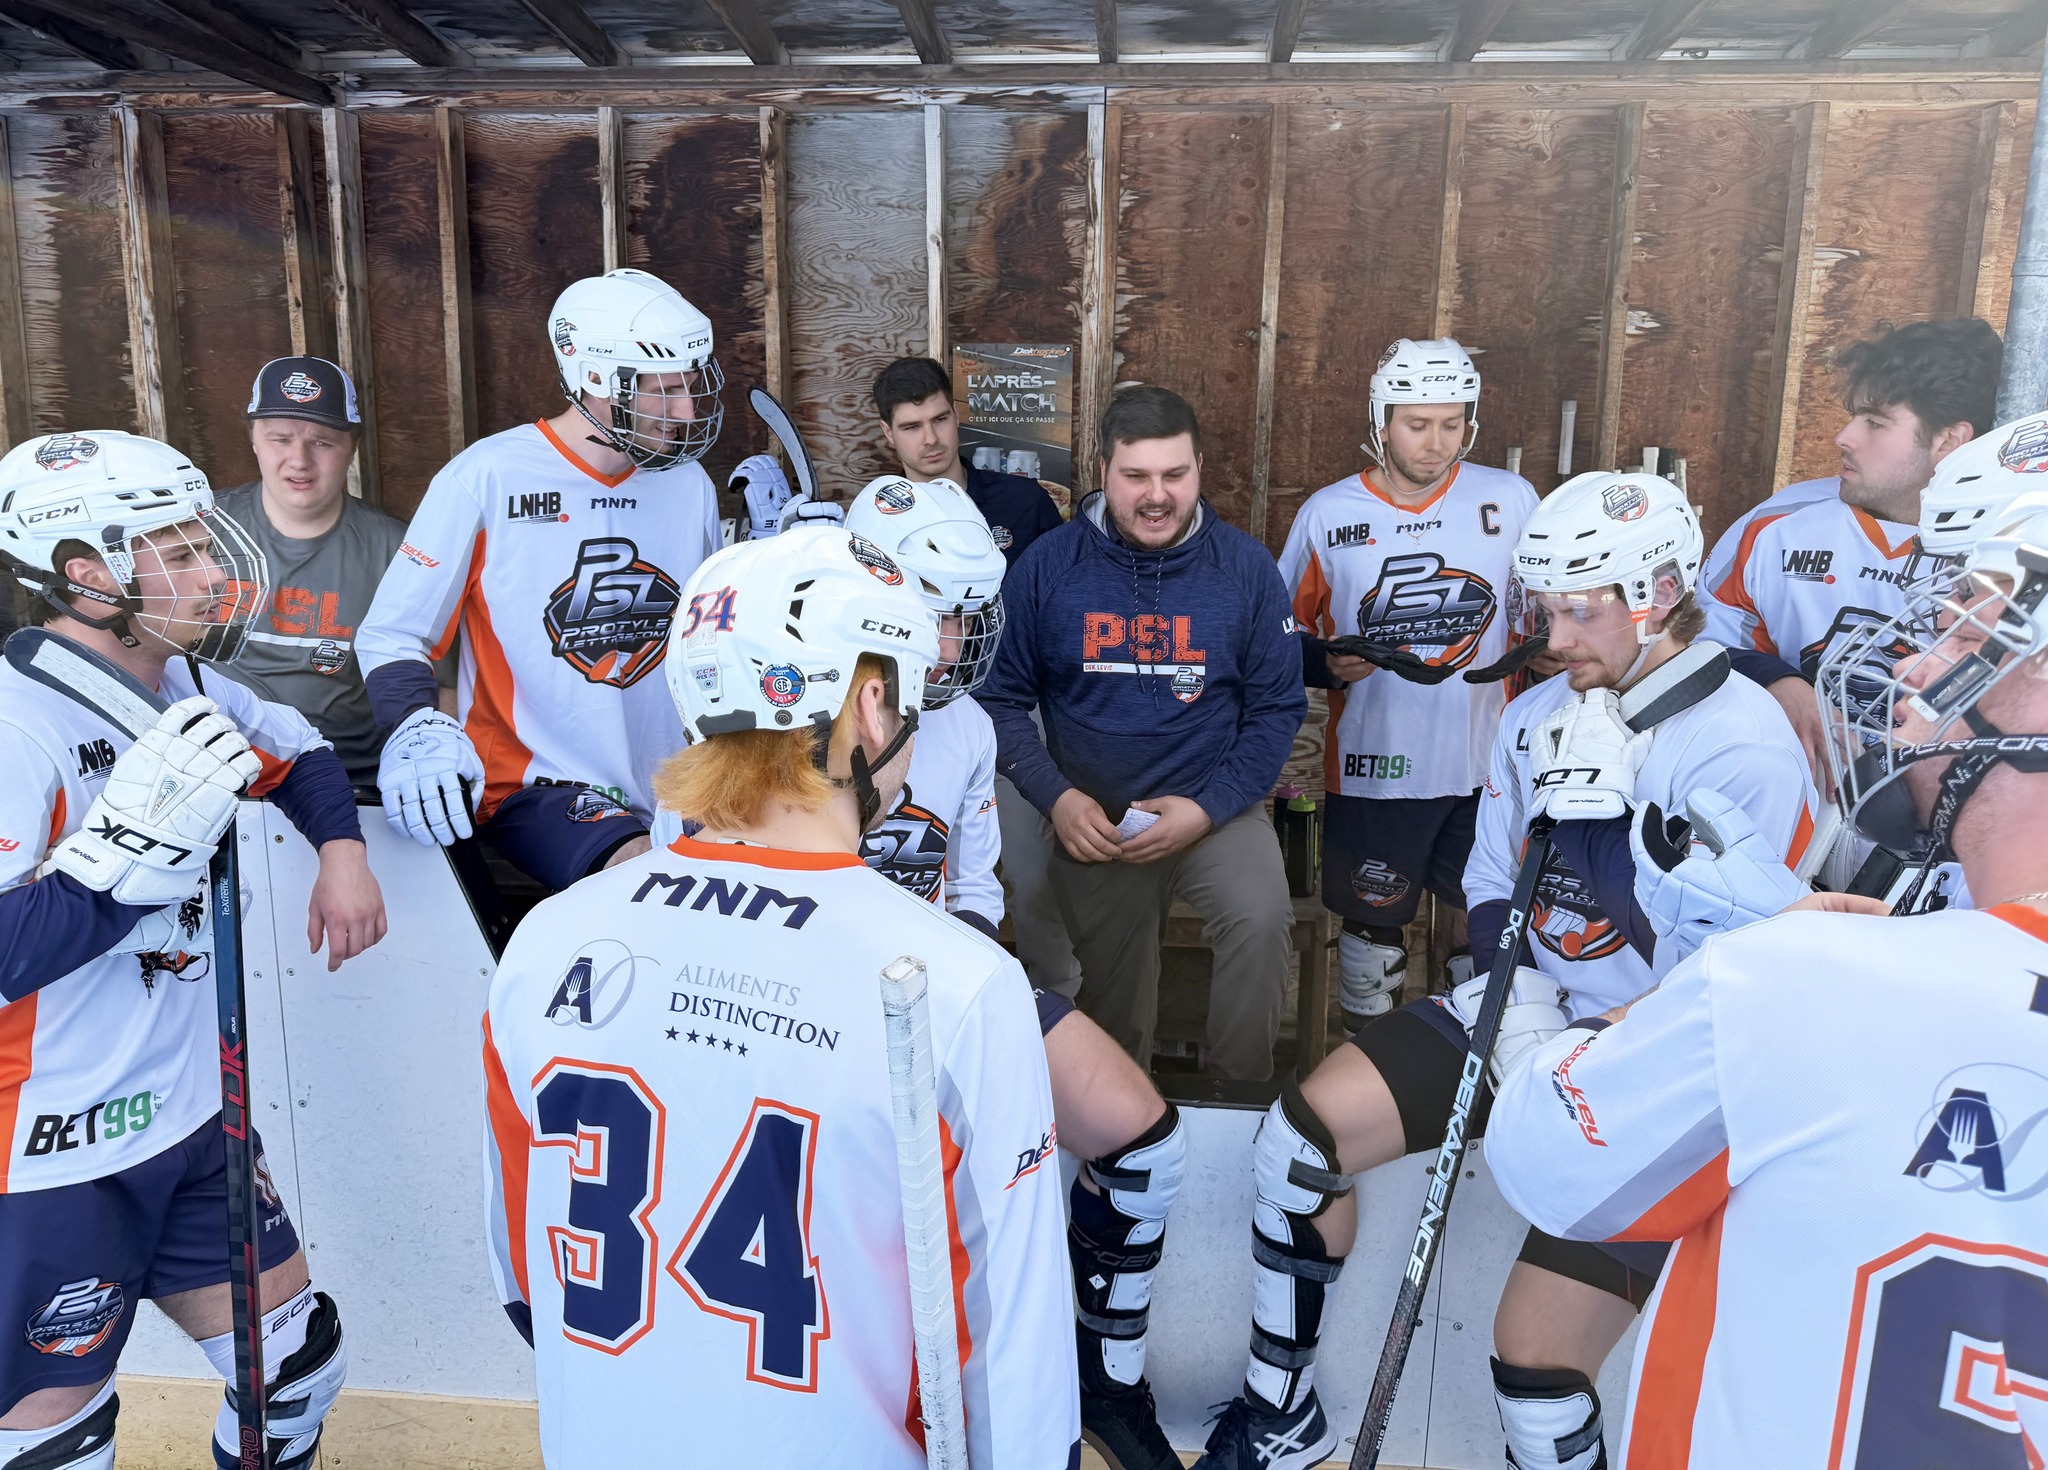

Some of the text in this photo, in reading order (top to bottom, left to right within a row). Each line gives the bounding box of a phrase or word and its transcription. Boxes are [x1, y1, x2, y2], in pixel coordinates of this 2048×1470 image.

[688, 337, 709, 349] CCM
[283, 372, 319, 389] PSL
[1421, 375, 1458, 383] CCM
[967, 393, 1057, 412] MATCH
[1015, 416, 1026, 424] ÇA
[28, 505, 80, 524] CCM
[508, 491, 562, 519] LNHB
[590, 497, 637, 510] MNM
[1395, 520, 1442, 534] MNM
[1478, 501, 1503, 538] C
[1327, 523, 1372, 549] LNHB
[400, 541, 440, 568] hockey
[1519, 555, 1551, 567] CCM
[1642, 539, 1675, 562] CCM
[1782, 548, 1834, 574] LNHB
[67, 582, 118, 604] CCM
[564, 541, 677, 623] PSL
[1369, 557, 1486, 623] PSL
[218, 580, 353, 638] PSL
[861, 619, 911, 640] CCM
[1083, 612, 1206, 663] PSL
[1365, 614, 1482, 639] PROSTYLE
[1372, 625, 1481, 642] ETTRAGE.COM
[697, 667, 716, 675] CCM
[775, 695, 793, 704] 2014
[1344, 753, 1406, 780] BET99
[87, 814, 193, 867] LDK
[69, 847, 100, 865] PRIME
[630, 871, 819, 931] MNM
[675, 962, 801, 1008] ALIMENTS
[669, 990, 842, 1052] DISTINCTION
[219, 1033, 247, 1141] LDK
[24, 1090, 151, 1157] BET99
[1406, 1050, 1483, 1288] DEKADENCE
[530, 1055, 831, 1394] 34
[34, 1276, 122, 1327] PSL
[28, 1303, 122, 1341] PROSTYLE
[1376, 1428, 1387, 1450] MID
[1382, 1402, 1394, 1429] KICK
